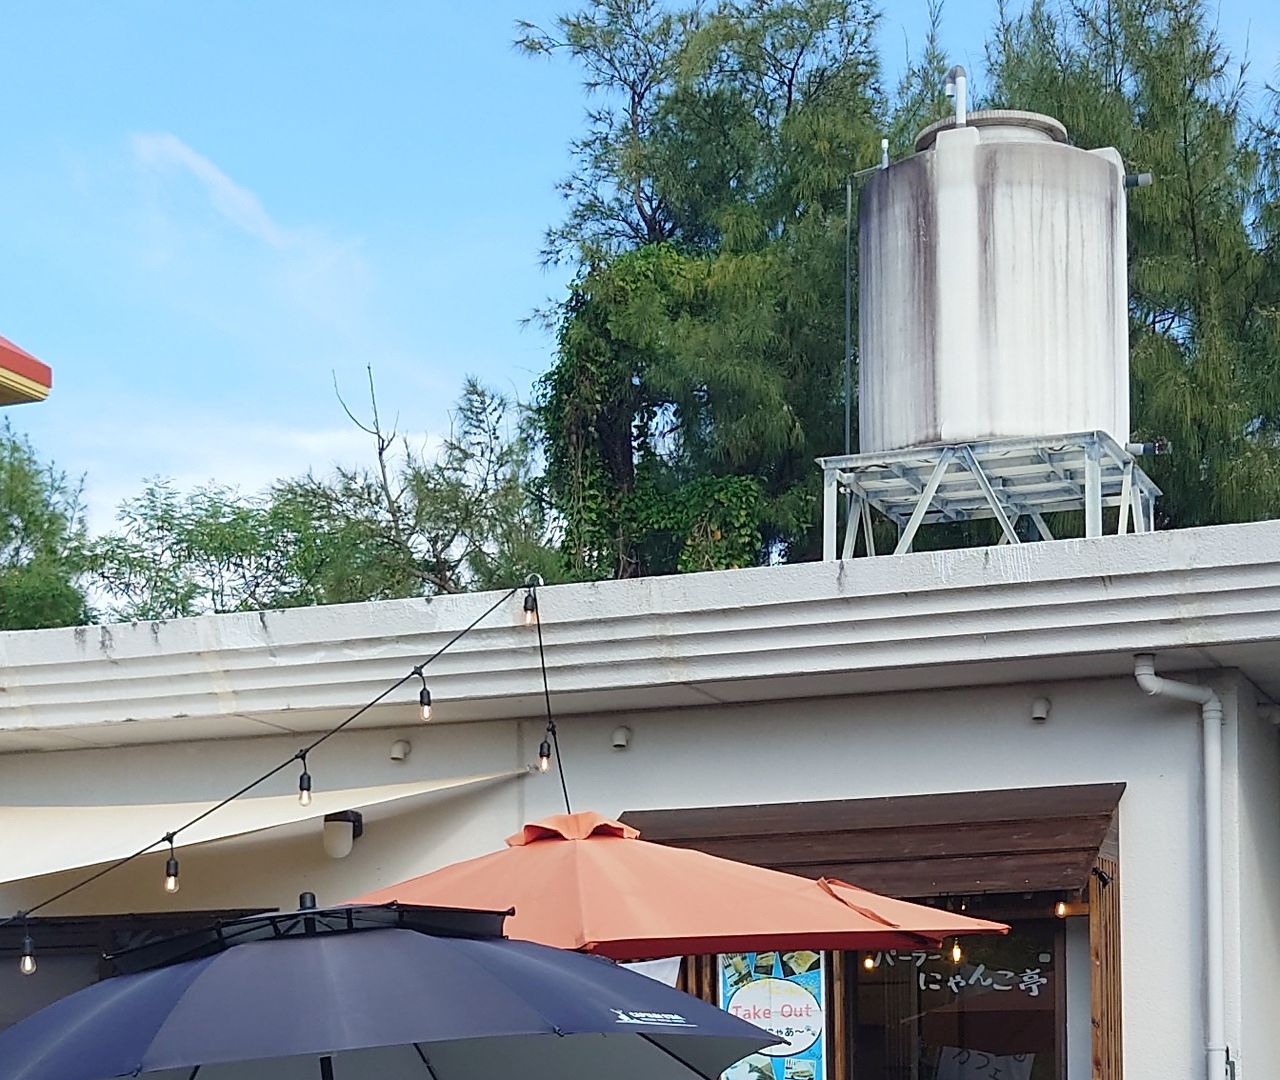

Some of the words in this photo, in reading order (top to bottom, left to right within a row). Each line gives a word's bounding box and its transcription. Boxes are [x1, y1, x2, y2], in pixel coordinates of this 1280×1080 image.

[874, 949, 942, 968] パーラー
[919, 963, 1048, 997] にゃんこ亭
[732, 1004, 771, 1019] Take
[780, 1003, 813, 1018] Out
